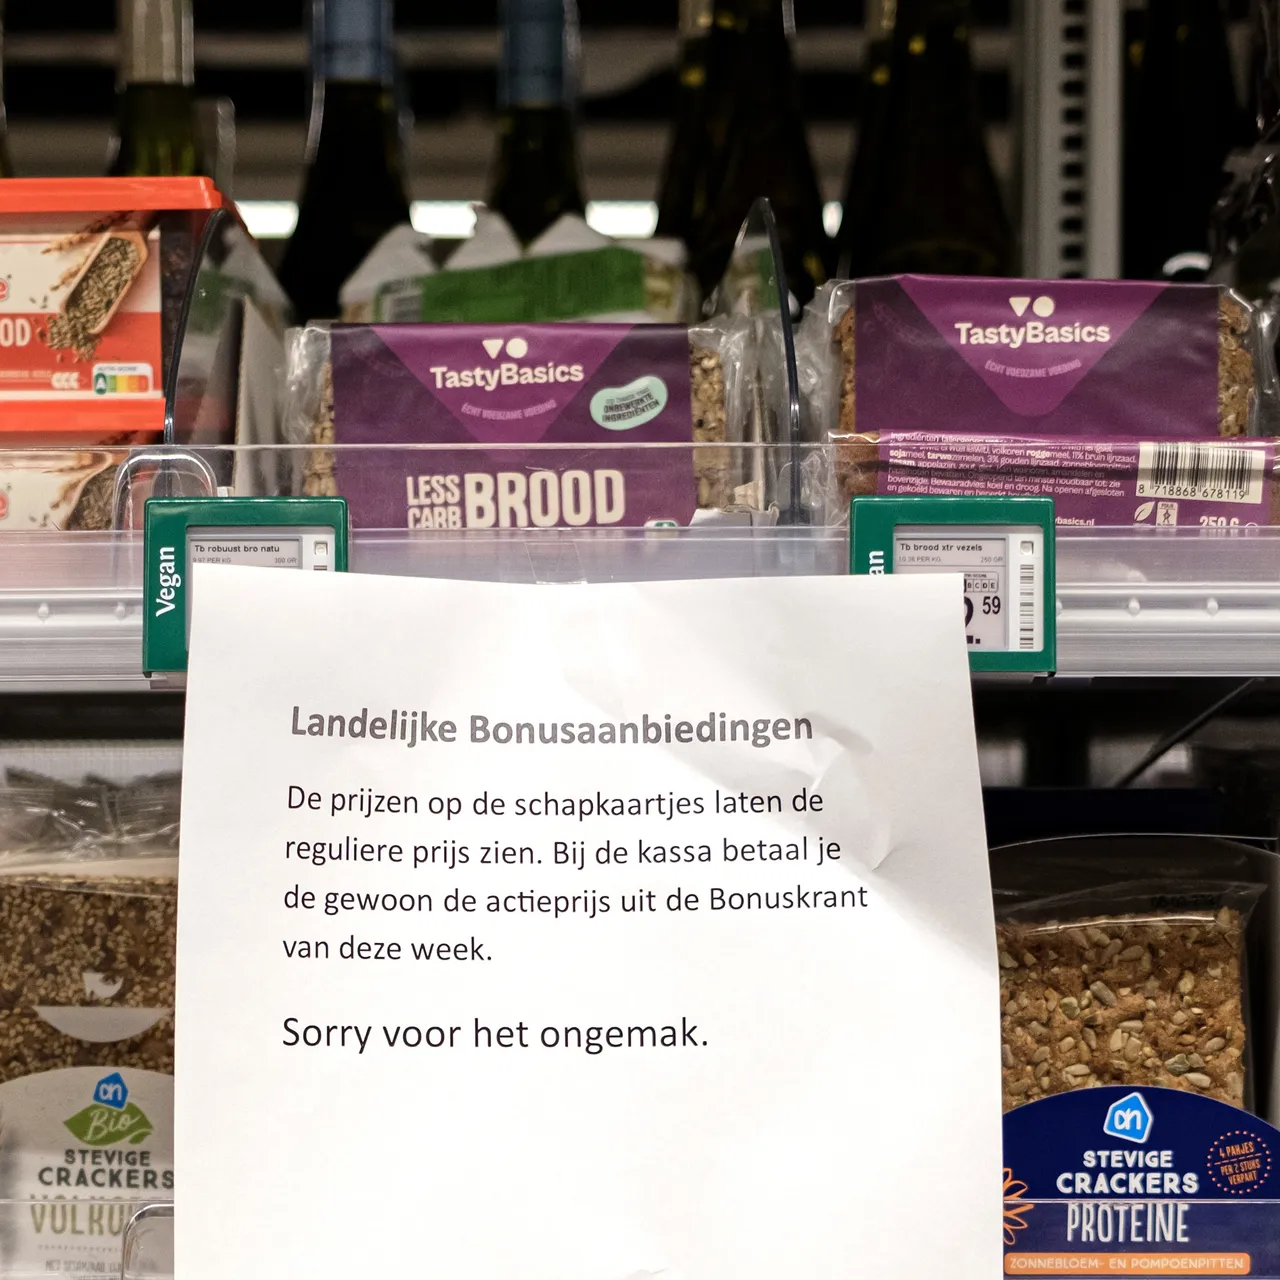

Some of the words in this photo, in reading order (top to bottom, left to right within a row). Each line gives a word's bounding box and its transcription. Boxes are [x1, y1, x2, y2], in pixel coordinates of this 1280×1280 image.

[954, 321, 1111, 348] TastyBasics
[429, 362, 584, 391] TastyBasics
[992, 448, 1024, 457] volkoren
[406, 475, 461, 505] LESS
[464, 469, 625, 528] BROOD
[1154, 486, 1197, 497] 718868
[1202, 489, 1245, 500] 678119
[408, 506, 462, 529] CARB
[900, 543, 911, 552] Tb
[913, 542, 939, 552] brood
[942, 543, 953, 552] xtr
[956, 543, 982, 552] vezels
[291, 705, 457, 748] Landelijke
[470, 711, 813, 749] Bonusaanbiedingen
[287, 785, 322, 811] De
[331, 787, 418, 819] prijzen
[428, 796, 462, 821] op
[472, 790, 506, 816] de
[514, 790, 705, 823] schapkaartjes
[715, 789, 782, 814] laten
[791, 786, 824, 813] de
[285, 835, 404, 867] reguliere
[413, 839, 470, 870] prijs
[479, 840, 542, 865] zien.
[553, 840, 585, 871] Bij
[595, 839, 628, 865] de
[638, 838, 712, 864] kassa
[723, 835, 808, 862] betaal
[816, 836, 841, 866] je
[283, 883, 316, 910] de
[324, 891, 433, 916] gewoon
[443, 887, 477, 913] de
[486, 889, 611, 919] actieprijs
[621, 888, 657, 913] uit
[666, 886, 700, 912] de
[710, 884, 869, 911] Bonuskrant
[282, 940, 329, 959] van
[339, 934, 402, 961] deze
[410, 935, 492, 961] week.
[282, 1017, 373, 1055] Sorry
[382, 1025, 462, 1048] voor
[474, 1017, 529, 1048] het
[540, 1016, 708, 1056] ongemak.
[85, 1109, 139, 1141] Bio
[65, 1149, 151, 1166] STEVIGE
[1083, 1150, 1174, 1168] STEVIGE
[38, 1167, 175, 1190] CRACKERS
[1056, 1172, 1199, 1195] CRACKERS
[1010, 1258, 1104, 1269] ZONNEBLOEM-
[1109, 1258, 1126, 1269] EN
[1131, 1258, 1244, 1269] POMPOENPITTEN
